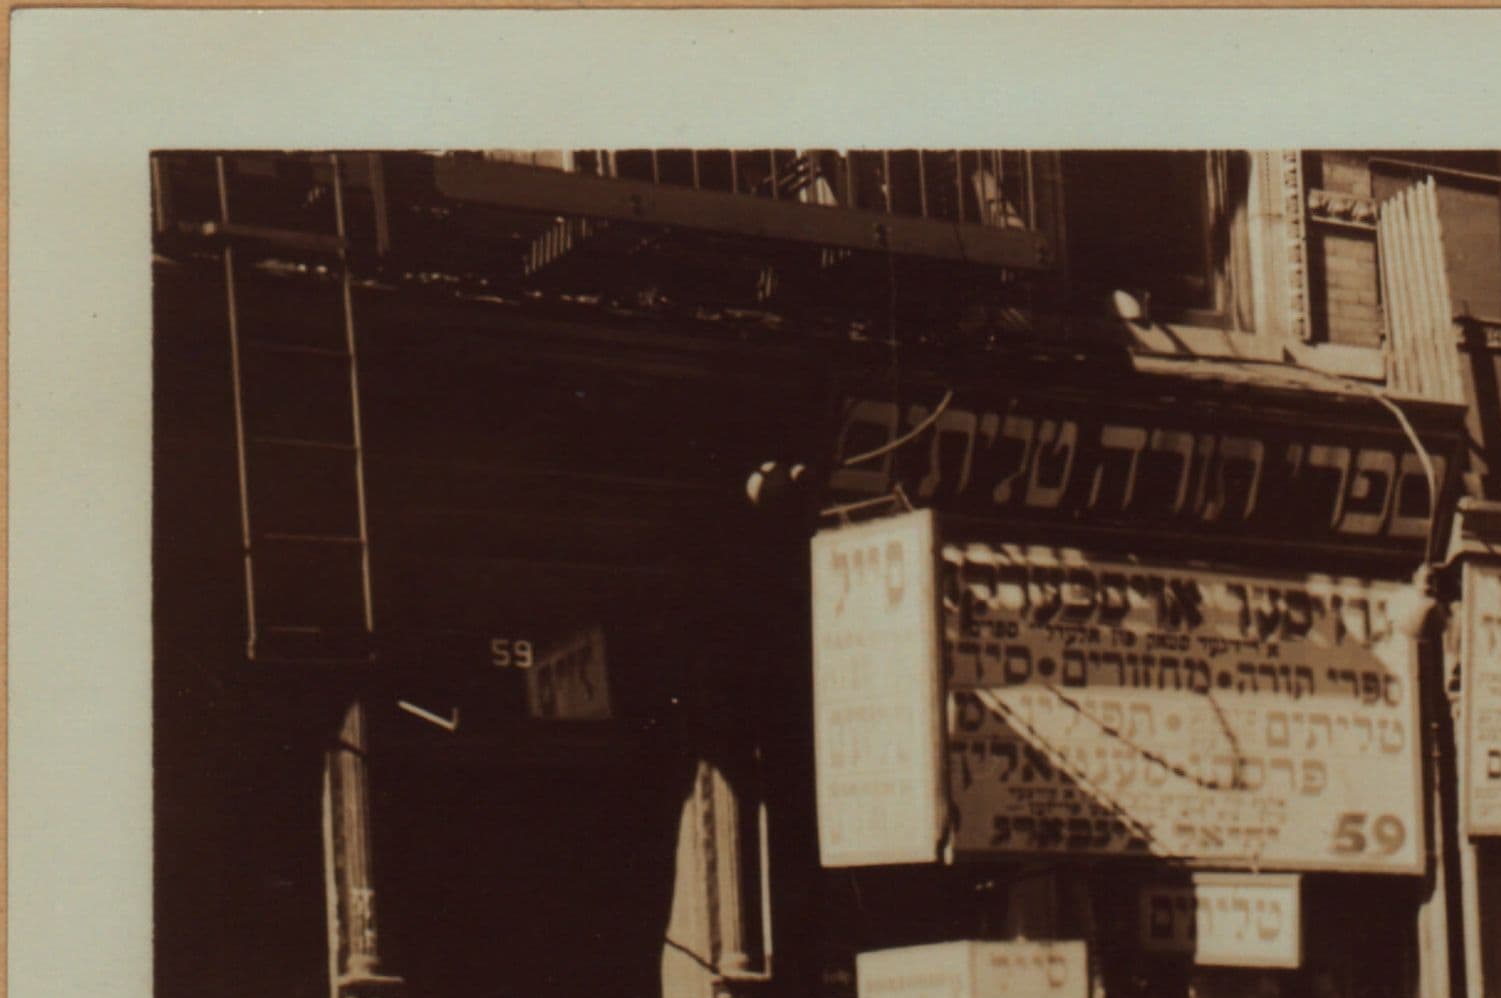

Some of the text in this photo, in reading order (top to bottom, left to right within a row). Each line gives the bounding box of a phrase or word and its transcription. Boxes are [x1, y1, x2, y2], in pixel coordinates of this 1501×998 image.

[832, 400, 1446, 540] ספרי תורה טליתים
[490, 639, 534, 669] 59
[1063, 648, 1212, 693] מחזורים
[1237, 660, 1315, 697] תורה
[1266, 711, 1406, 757] טליתים
[1334, 812, 1407, 860] 59
